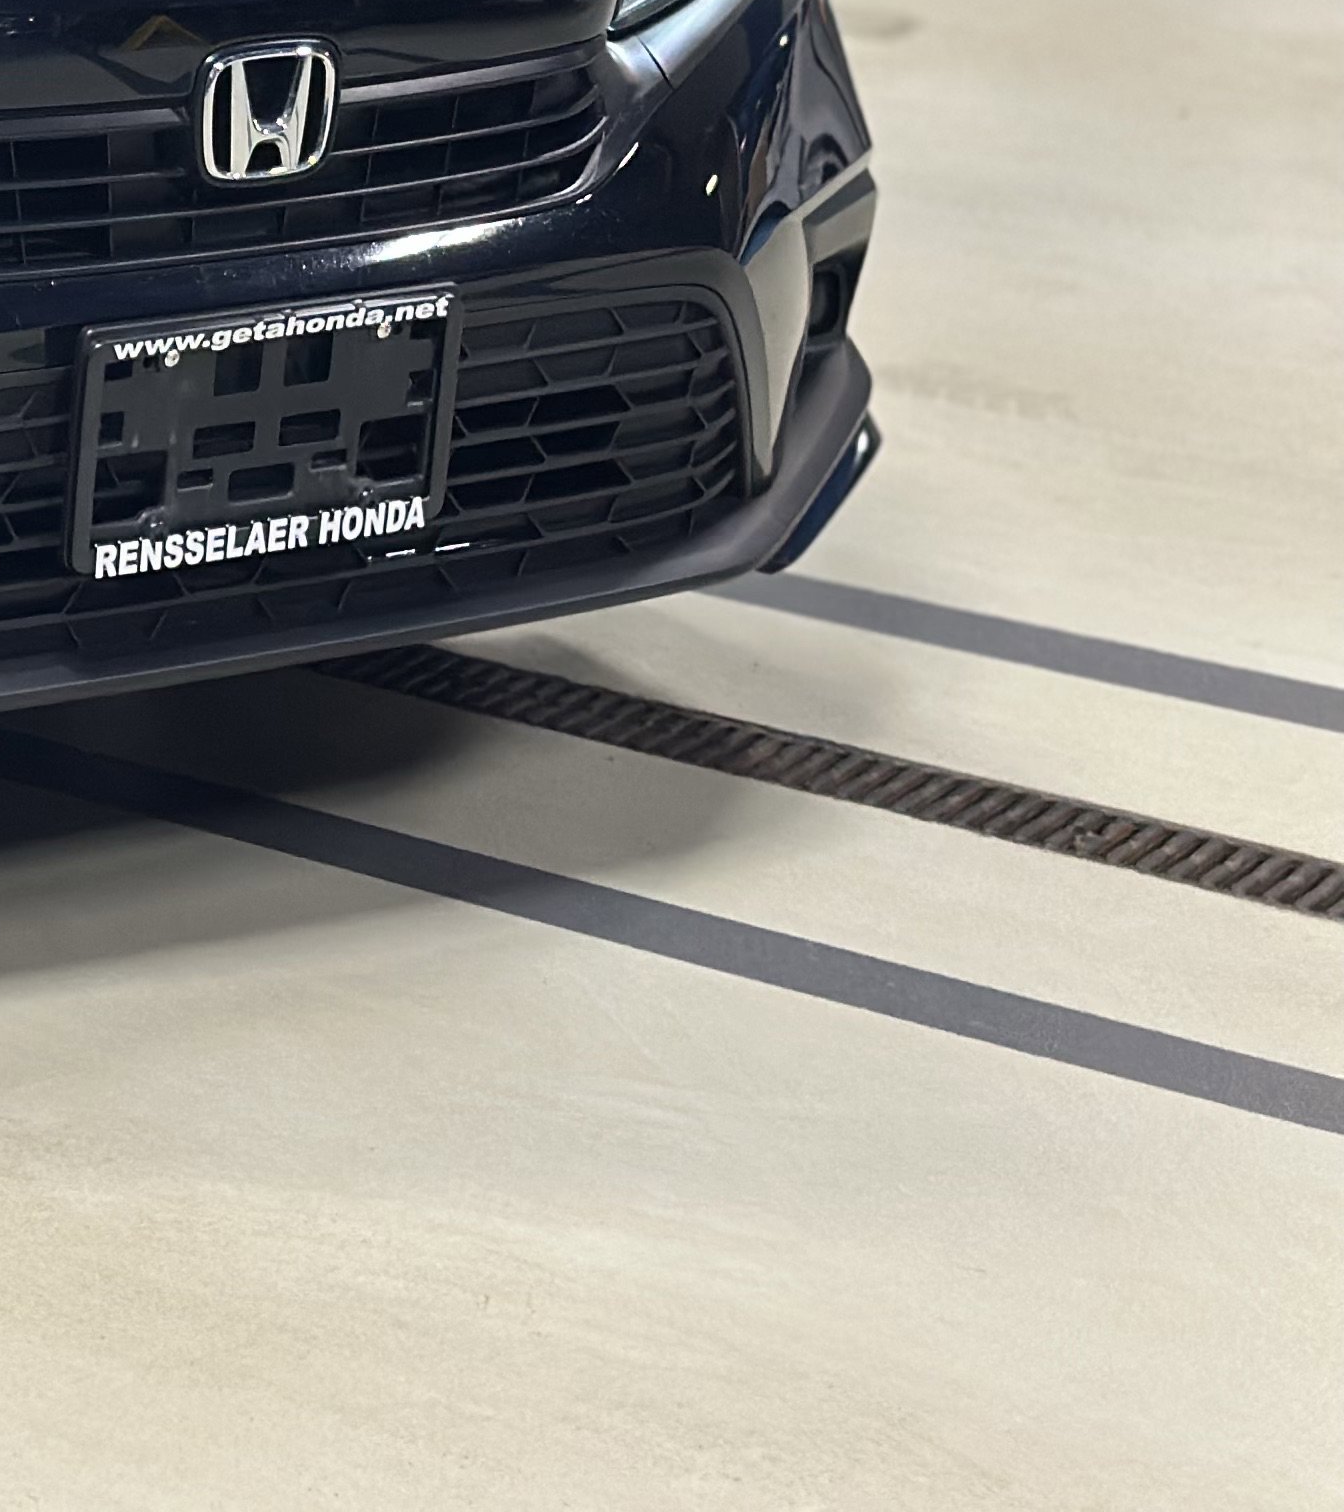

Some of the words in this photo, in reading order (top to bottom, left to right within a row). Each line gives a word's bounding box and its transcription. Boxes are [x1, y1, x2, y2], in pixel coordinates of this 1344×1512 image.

[113, 296, 449, 361] www.getahonda.net
[94, 515, 309, 579] RENSSELAER
[318, 496, 425, 545] HONDA
